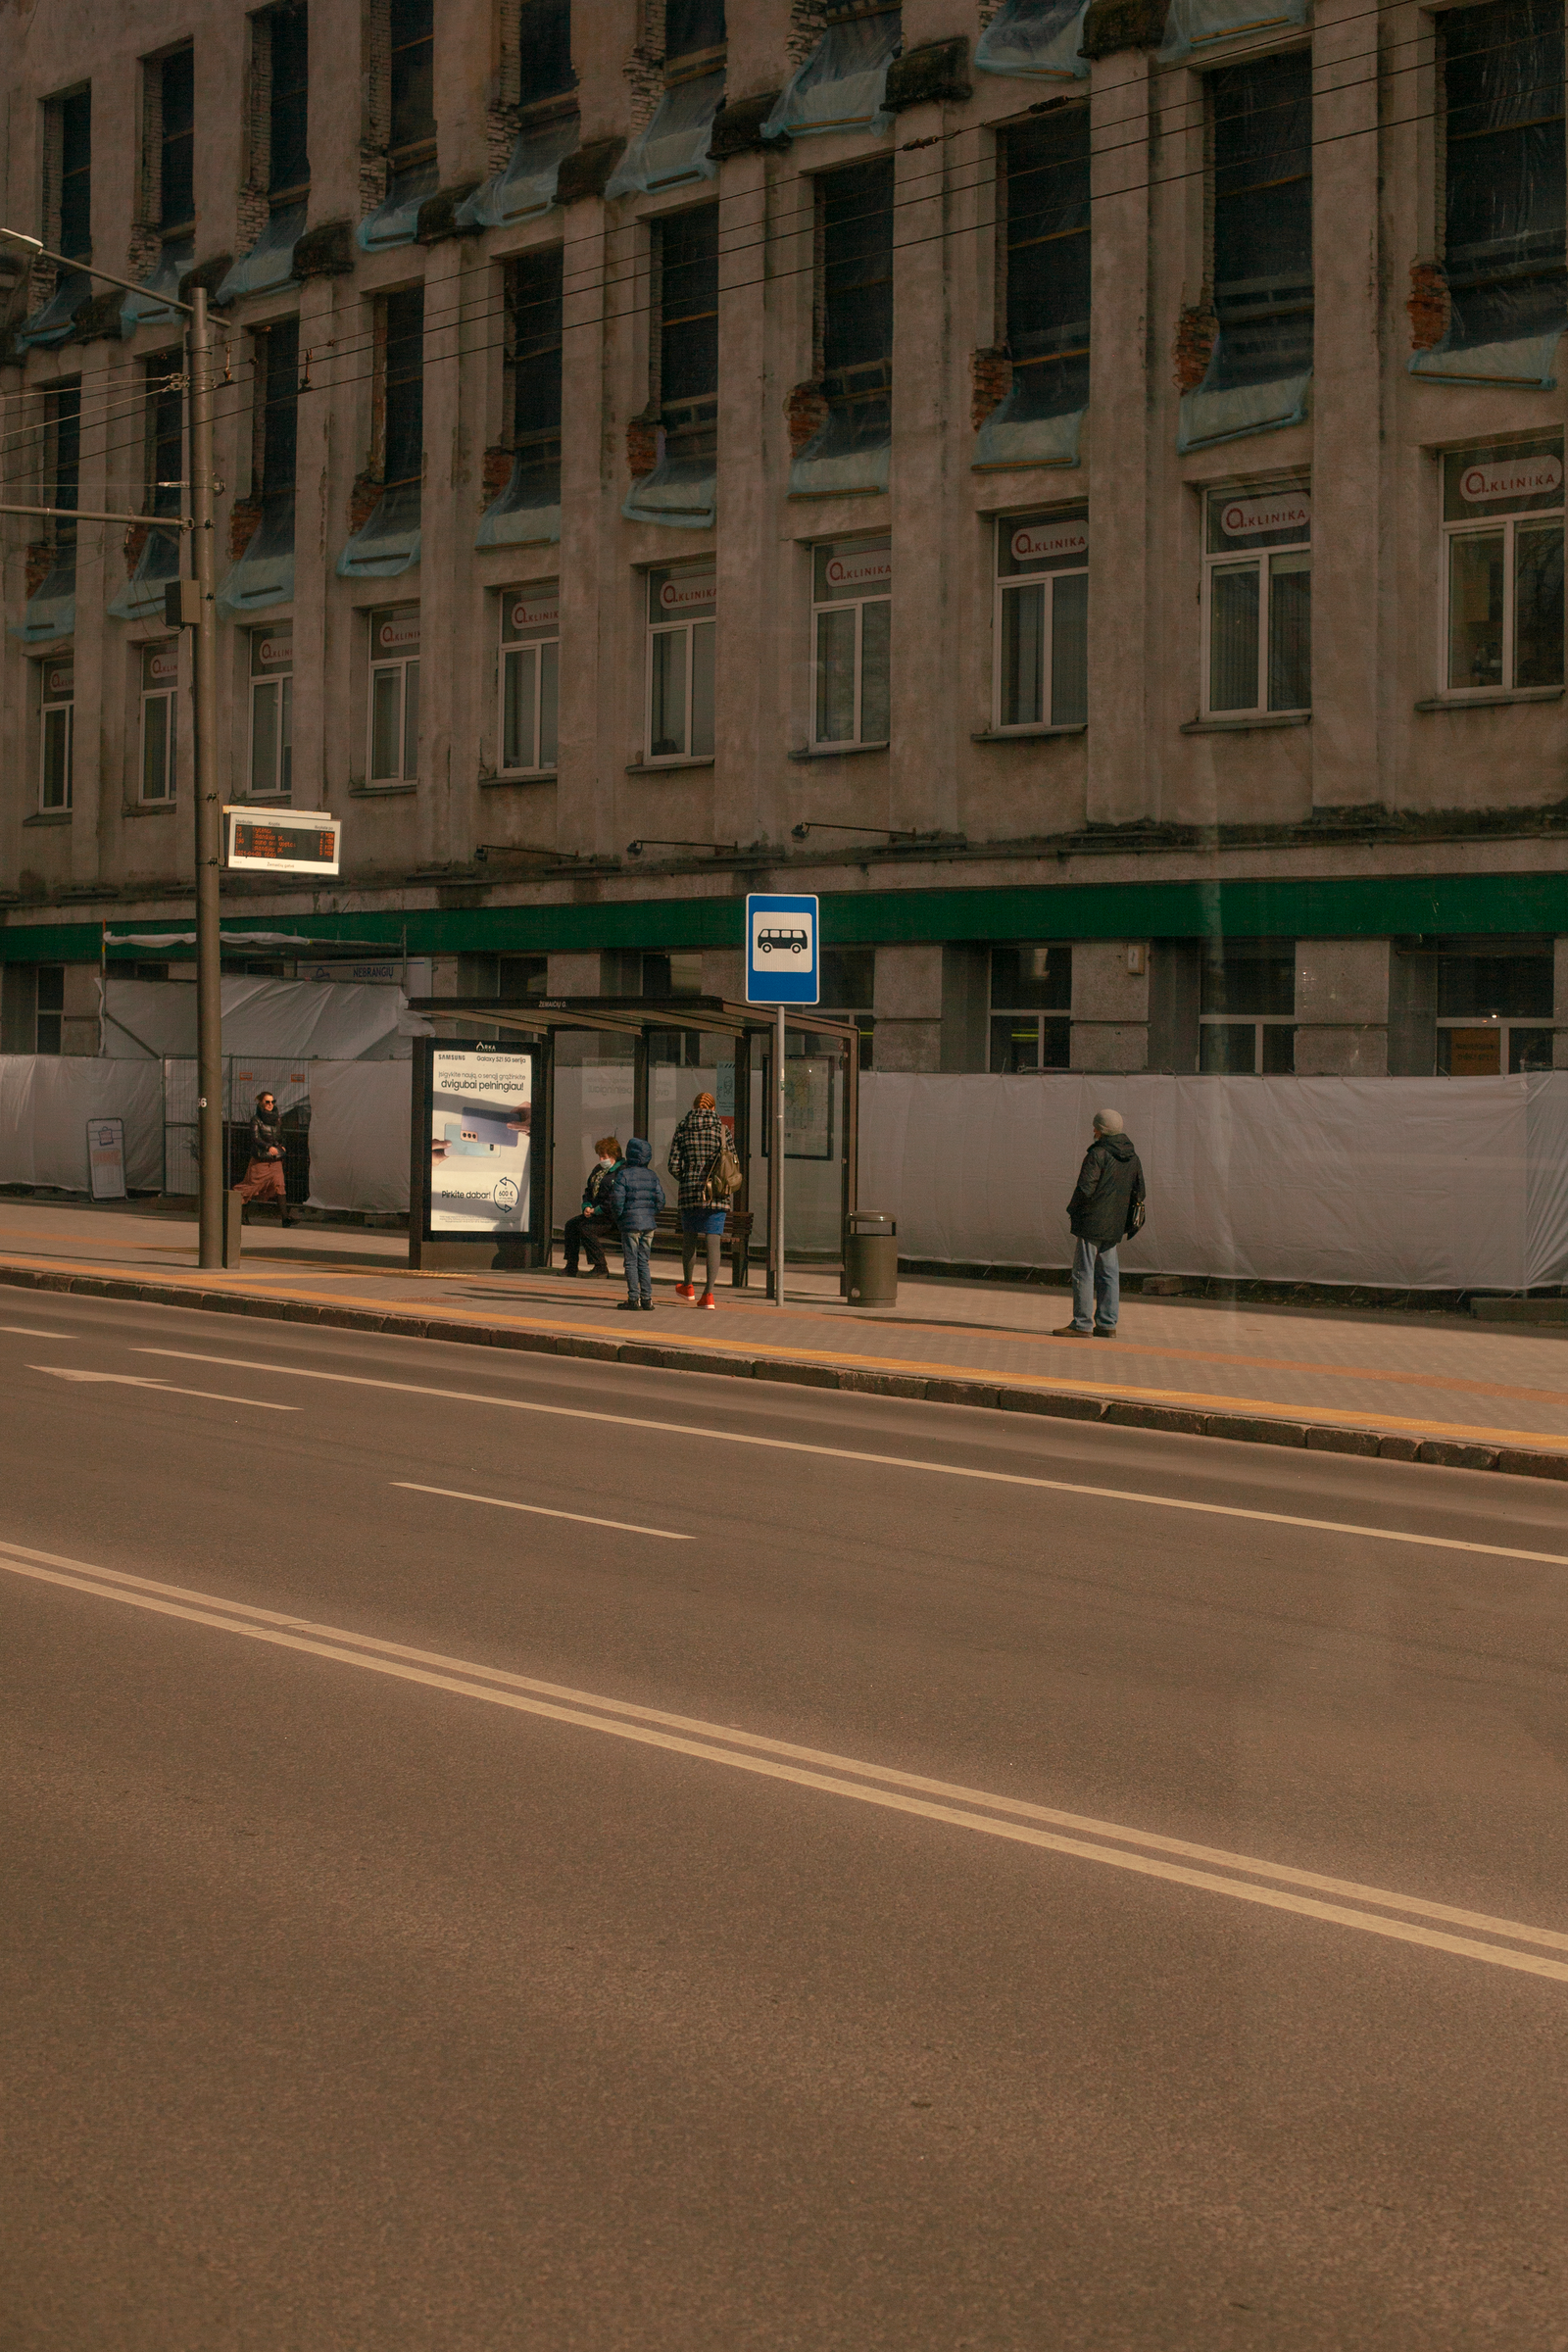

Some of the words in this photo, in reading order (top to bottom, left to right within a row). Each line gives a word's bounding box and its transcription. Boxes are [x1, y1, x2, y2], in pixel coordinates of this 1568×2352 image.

[353, 966, 394, 979] NEBRANGIŲ
[440, 1079, 478, 1091] dvigubai
[479, 1081, 524, 1093] pelningiau!
[441, 1190, 465, 1199] Pirkite
[466, 1191, 491, 1200] dabar!
